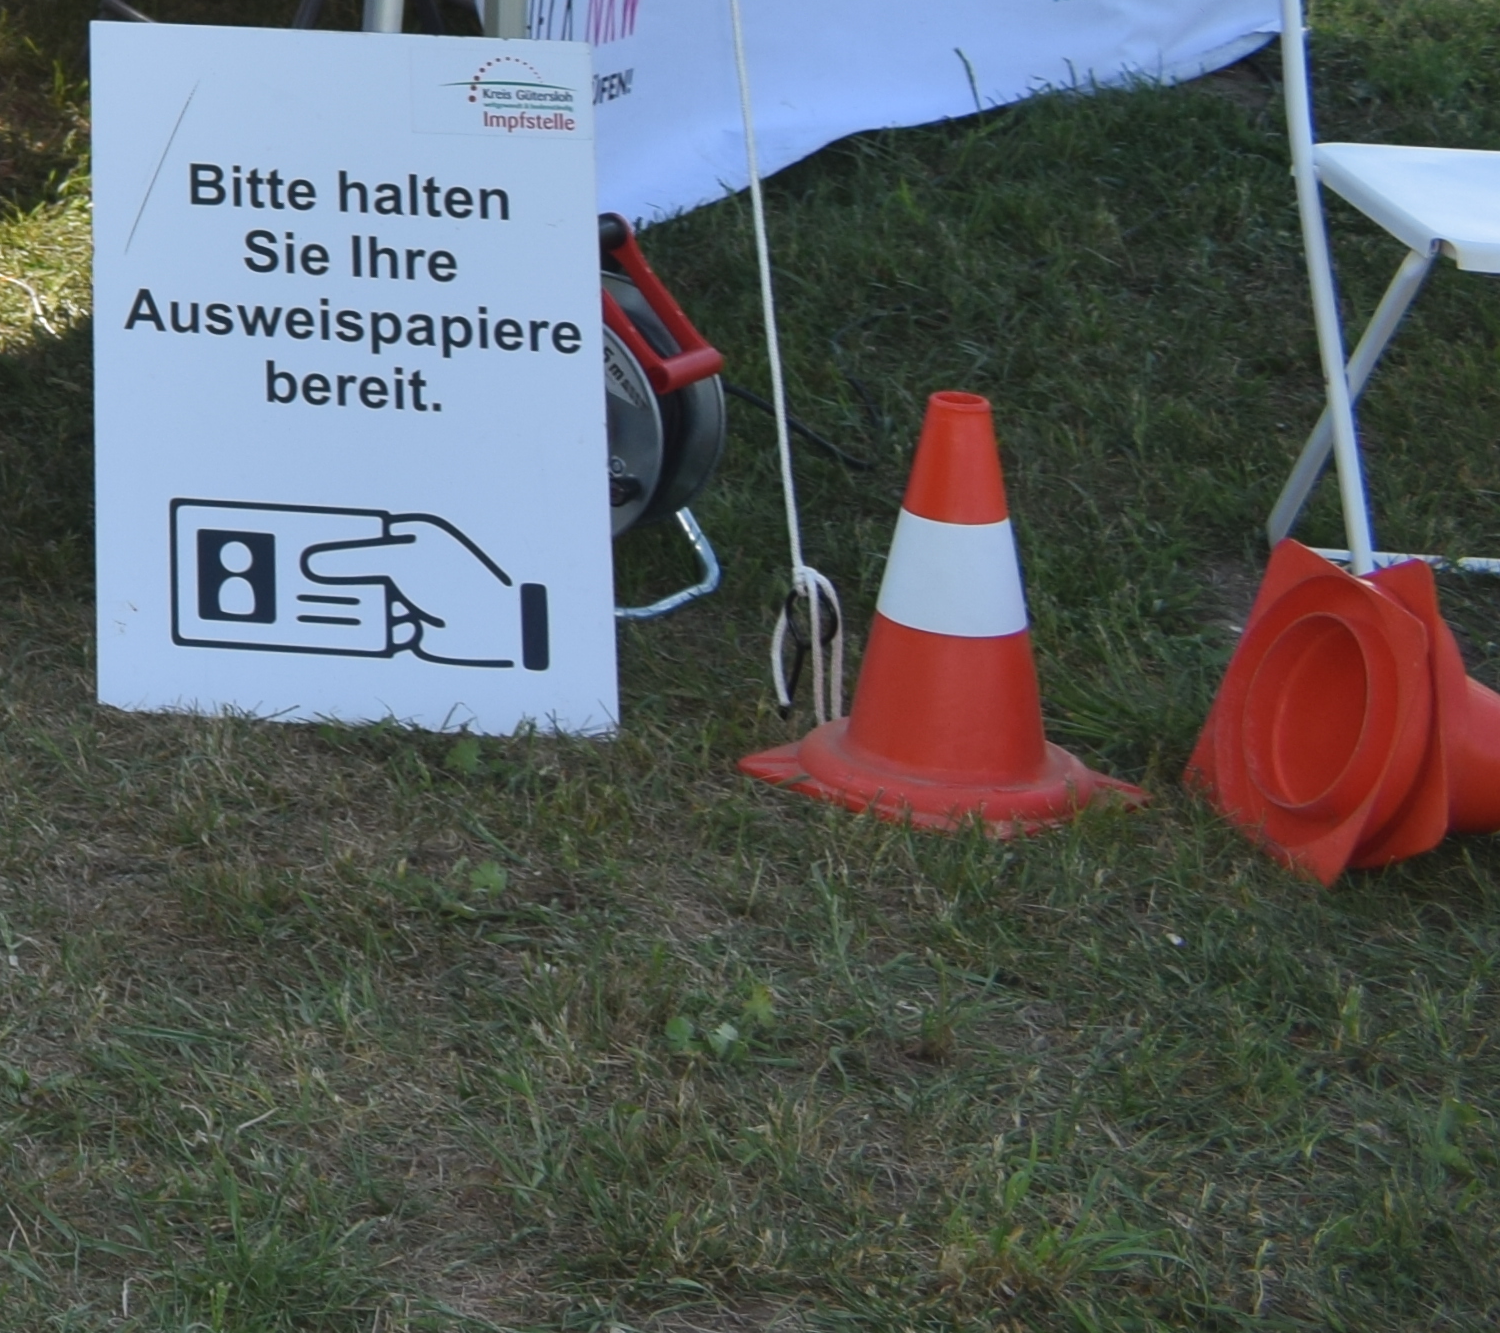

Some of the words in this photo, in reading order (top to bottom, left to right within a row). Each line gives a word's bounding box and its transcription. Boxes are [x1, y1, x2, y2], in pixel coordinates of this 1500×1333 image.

[482, 87, 512, 101] Kreis
[515, 88, 574, 103] Gütersloh
[482, 110, 576, 134] Impfstelle
[189, 162, 316, 211] Bitte
[338, 170, 510, 221] halten
[244, 229, 330, 276] Sie
[352, 235, 458, 283] Ihre
[125, 288, 582, 359] Ausweispapiere
[265, 360, 442, 413] bereit.
